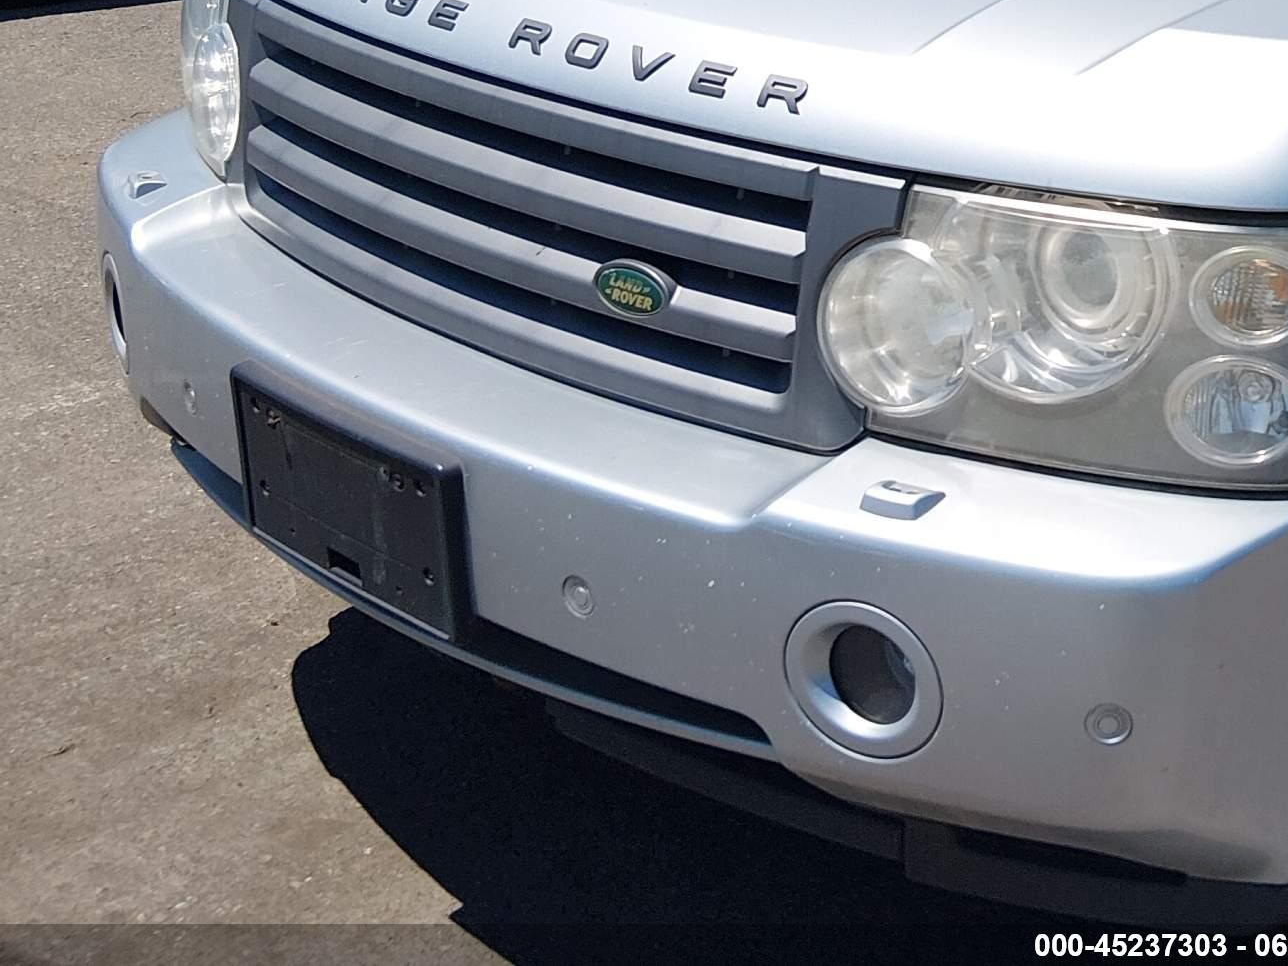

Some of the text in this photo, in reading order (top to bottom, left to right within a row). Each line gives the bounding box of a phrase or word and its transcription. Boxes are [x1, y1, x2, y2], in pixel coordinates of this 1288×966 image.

[508, 17, 808, 115] ROVER
[609, 272, 642, 293] LAND
[611, 287, 653, 311] ROVER
